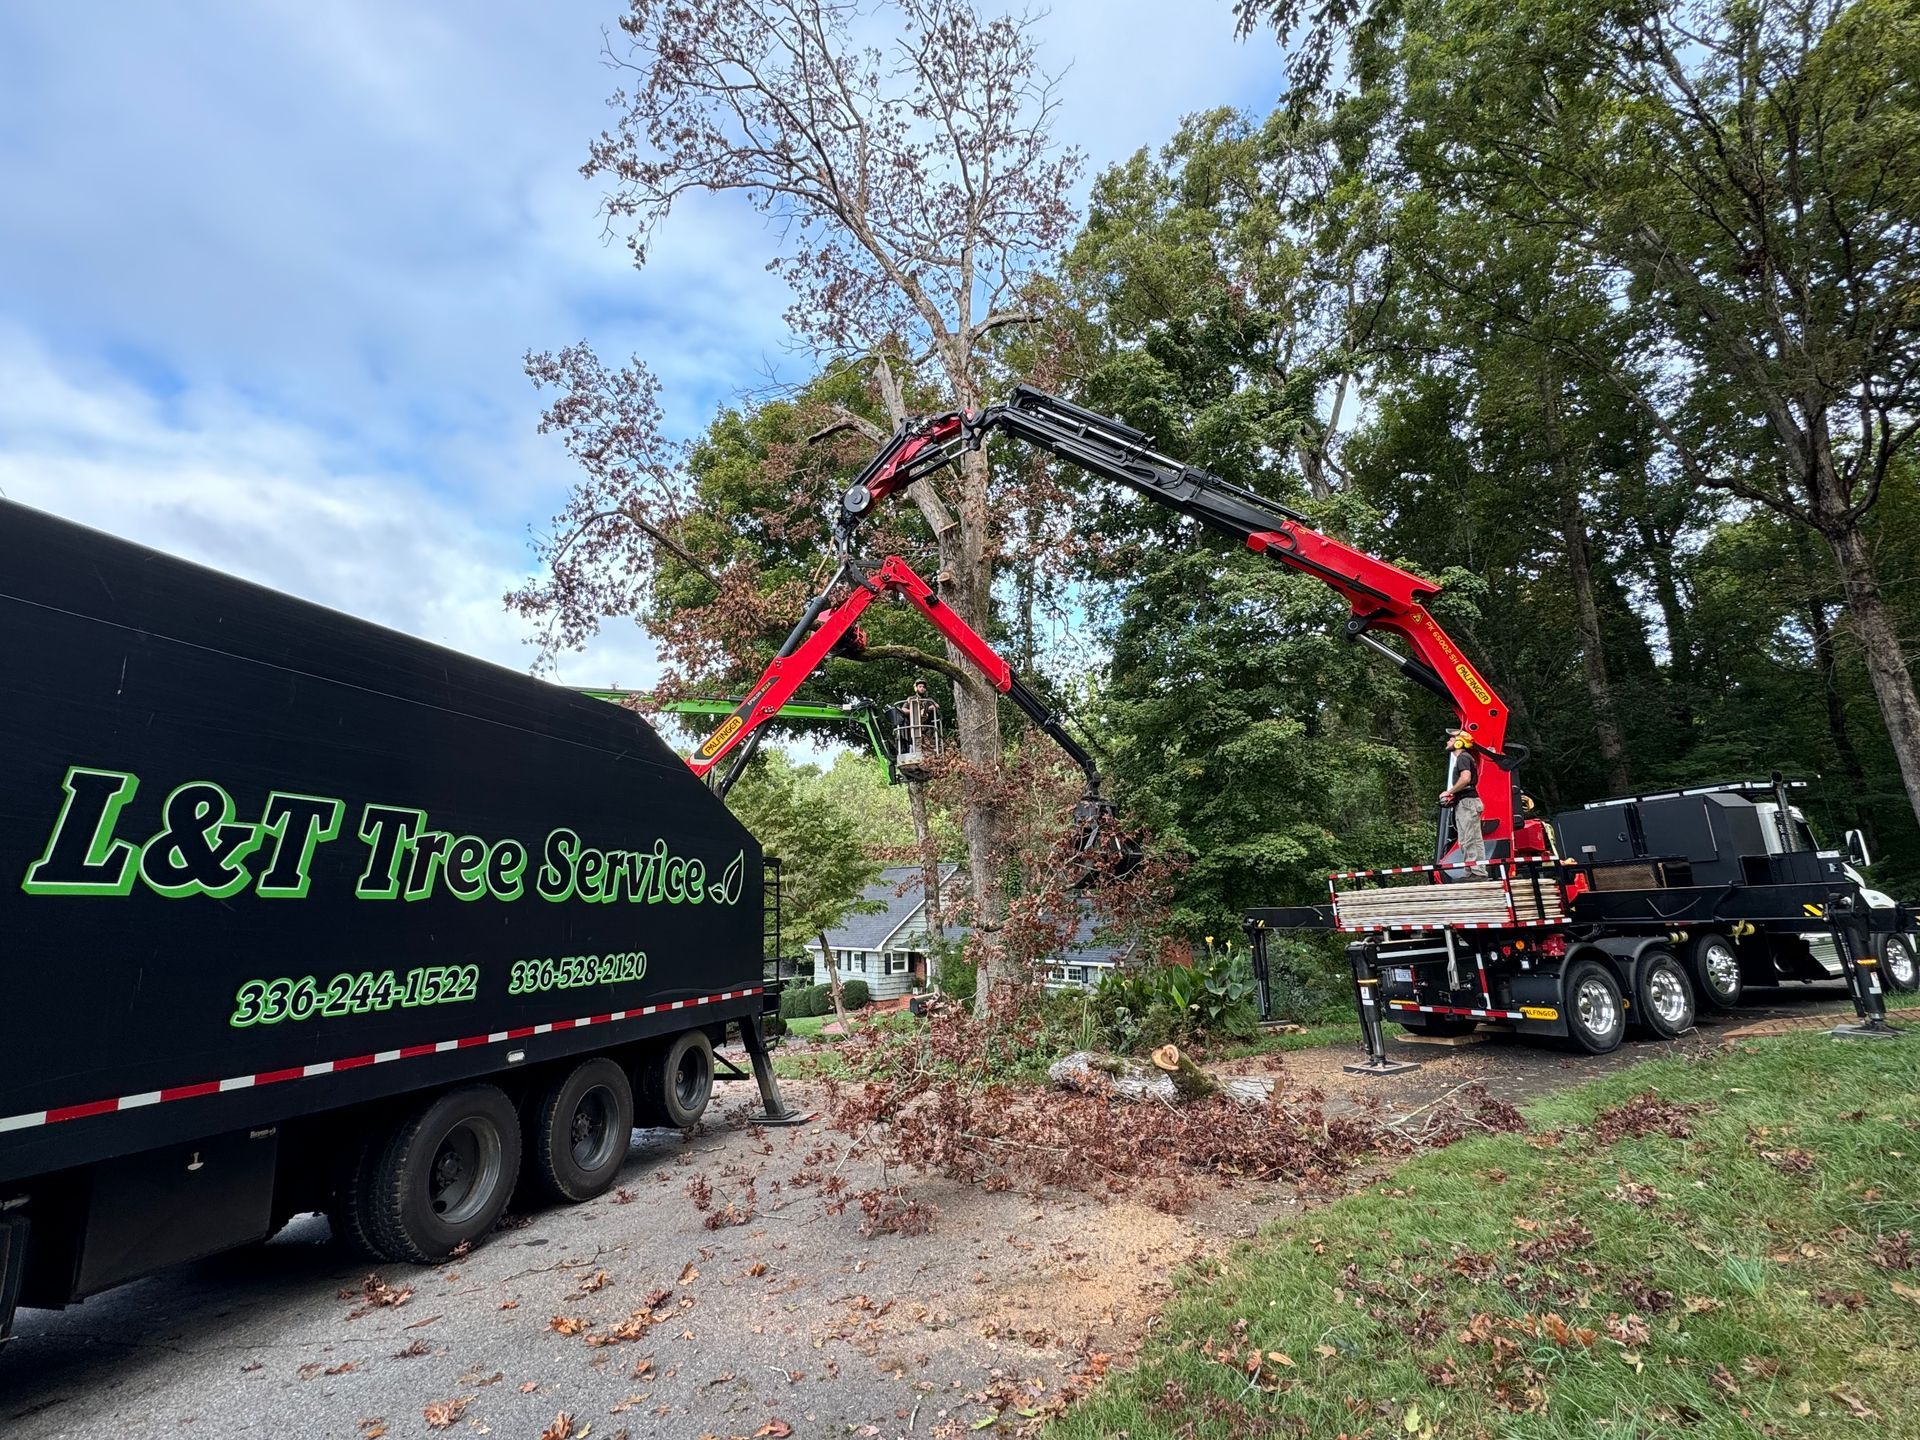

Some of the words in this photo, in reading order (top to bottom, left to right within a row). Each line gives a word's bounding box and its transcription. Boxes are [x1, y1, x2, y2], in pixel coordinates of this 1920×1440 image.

[1458, 666, 1488, 702] PALFINGER
[705, 719, 740, 754] PALFINGER
[21, 765, 346, 898] L&T
[355, 803, 528, 901] Tree
[536, 827, 706, 904] Service
[508, 951, 647, 995] 336-528-2120
[230, 964, 479, 1027] 336-244-1522
